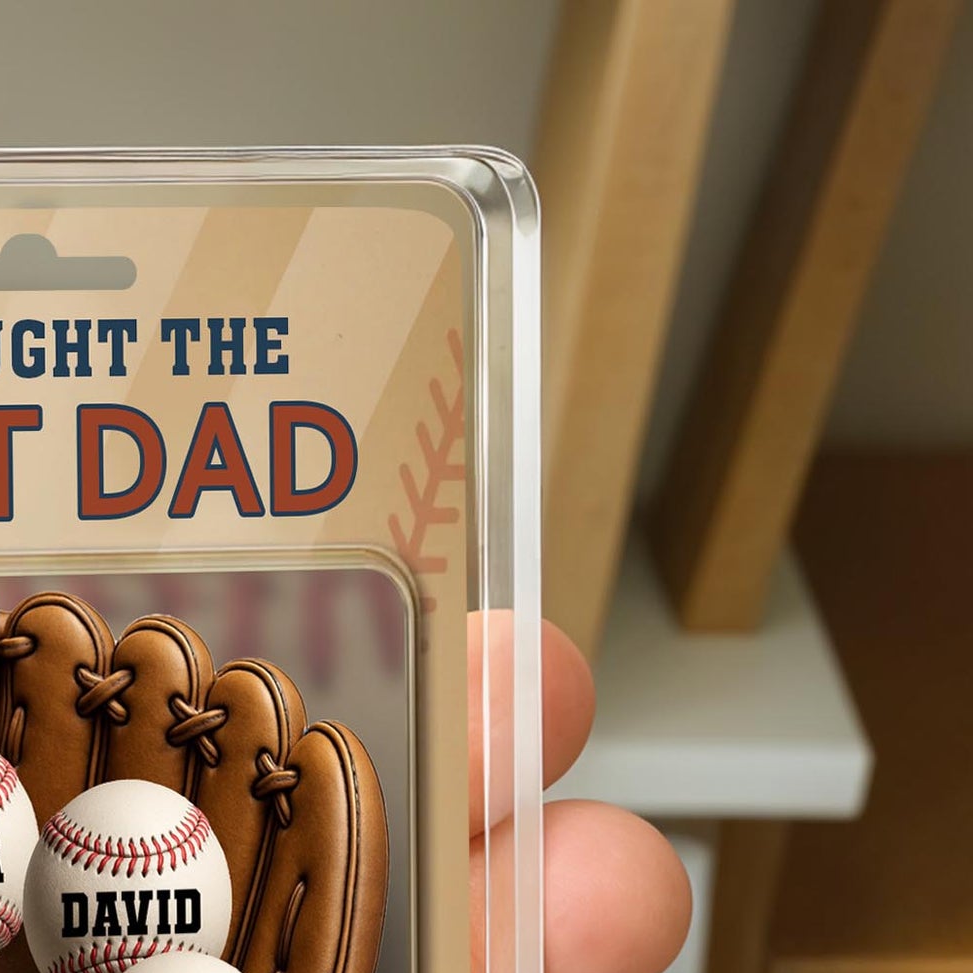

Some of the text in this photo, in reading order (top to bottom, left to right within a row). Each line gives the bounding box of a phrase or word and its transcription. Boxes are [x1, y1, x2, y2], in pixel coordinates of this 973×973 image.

[160, 317, 290, 376] THE
[77, 401, 358, 520] DAD
[60, 888, 202, 938] DAVID
